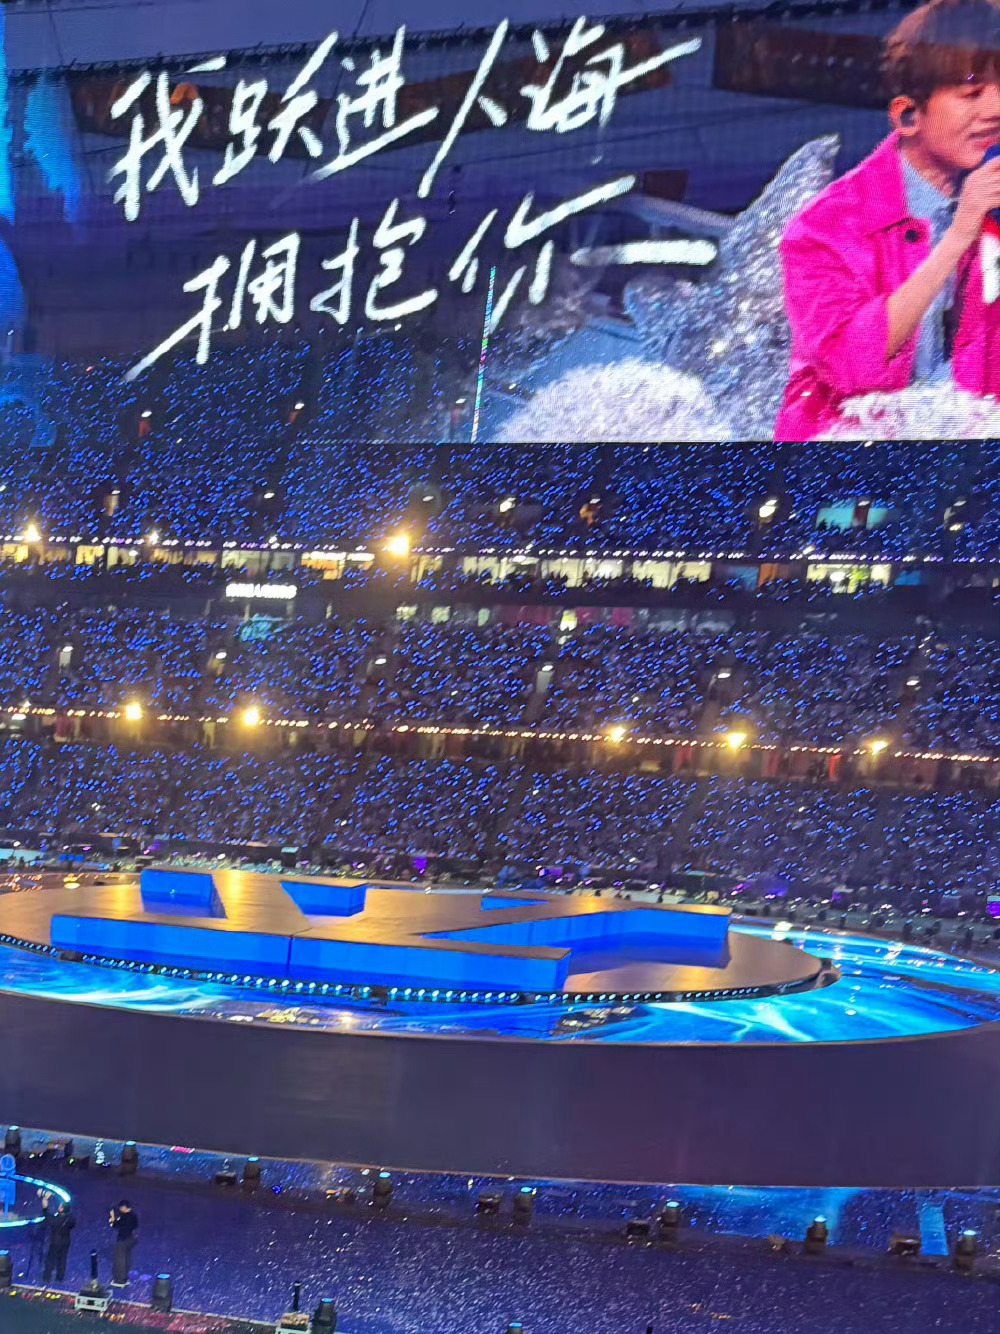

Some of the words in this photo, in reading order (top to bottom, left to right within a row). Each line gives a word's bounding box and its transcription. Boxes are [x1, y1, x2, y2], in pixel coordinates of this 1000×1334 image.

[109, 16, 701, 221] 我跃进人海
